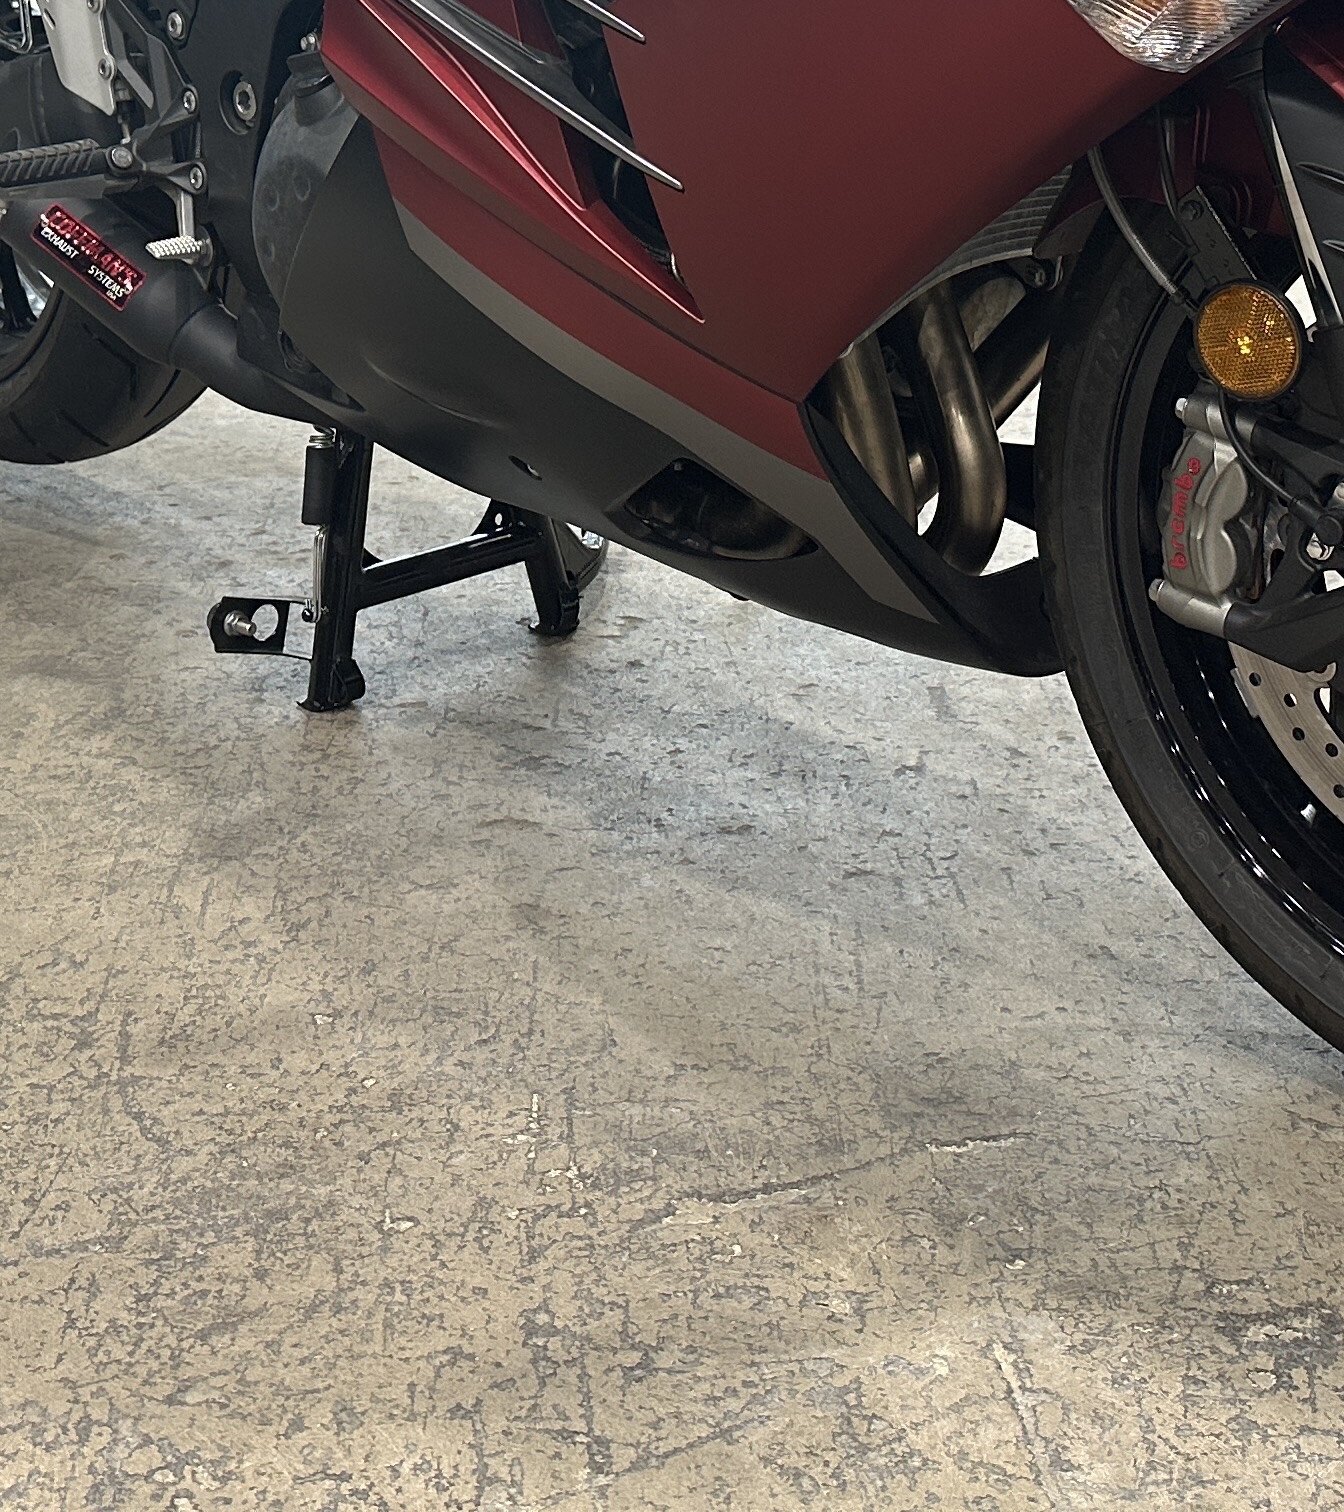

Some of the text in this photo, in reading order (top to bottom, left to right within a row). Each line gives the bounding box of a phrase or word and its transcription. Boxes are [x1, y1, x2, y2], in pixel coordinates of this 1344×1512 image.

[40, 226, 126, 298] EXHAUST SYSTEMS
[1169, 457, 1201, 569] brembo
